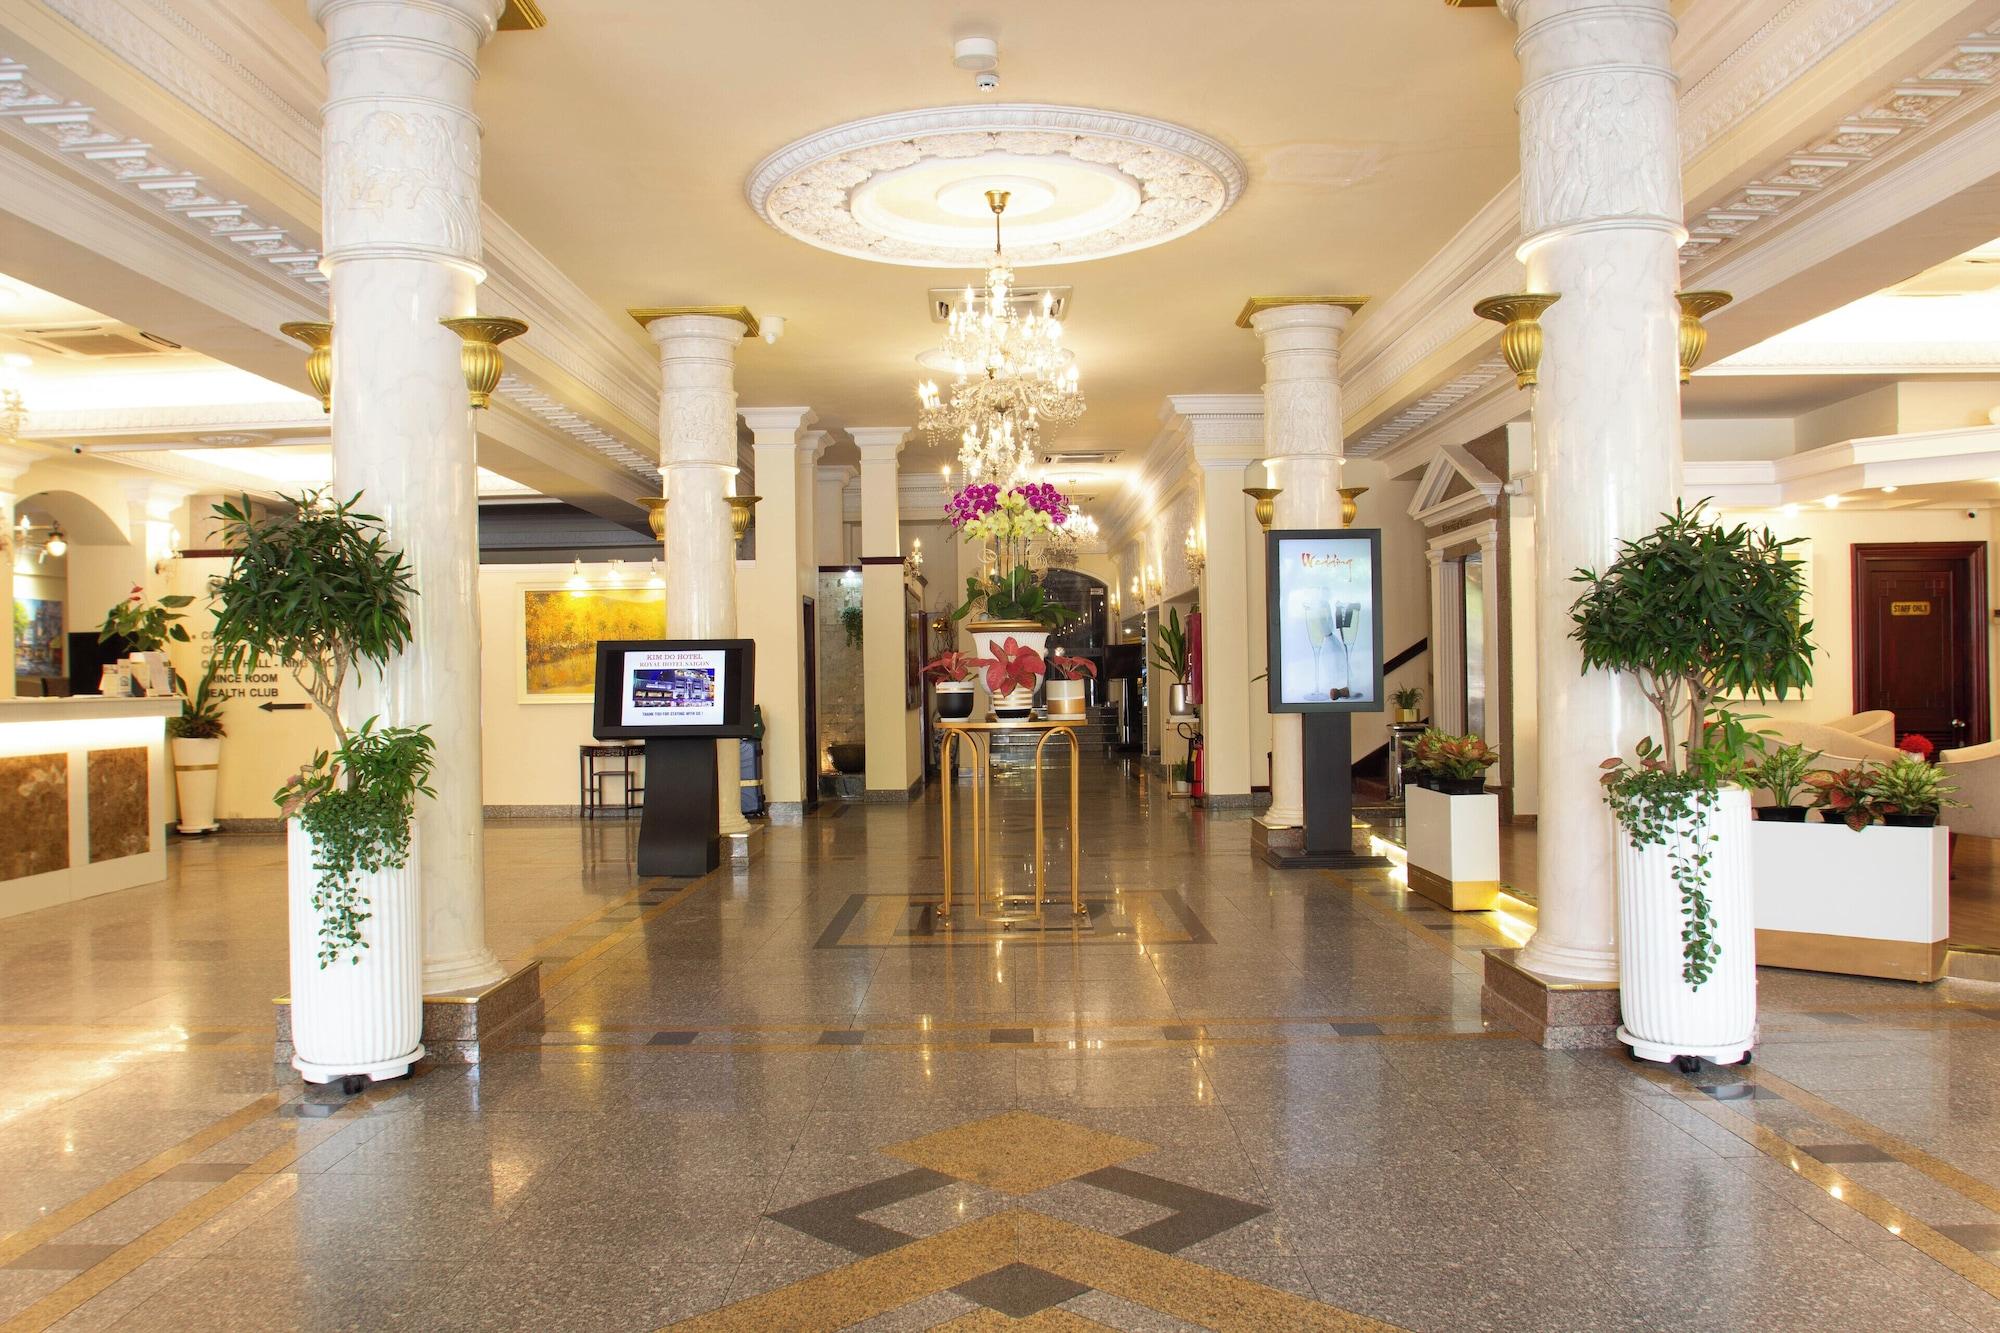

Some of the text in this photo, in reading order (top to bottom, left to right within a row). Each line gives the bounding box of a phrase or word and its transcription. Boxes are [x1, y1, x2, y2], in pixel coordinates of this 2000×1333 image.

[1302, 552, 1352, 582] Wedding
[1893, 604, 1929, 612] STAFF ONLY
[245, 673, 278, 683] ROOM
[207, 688, 279, 698] EALTH CLUB
